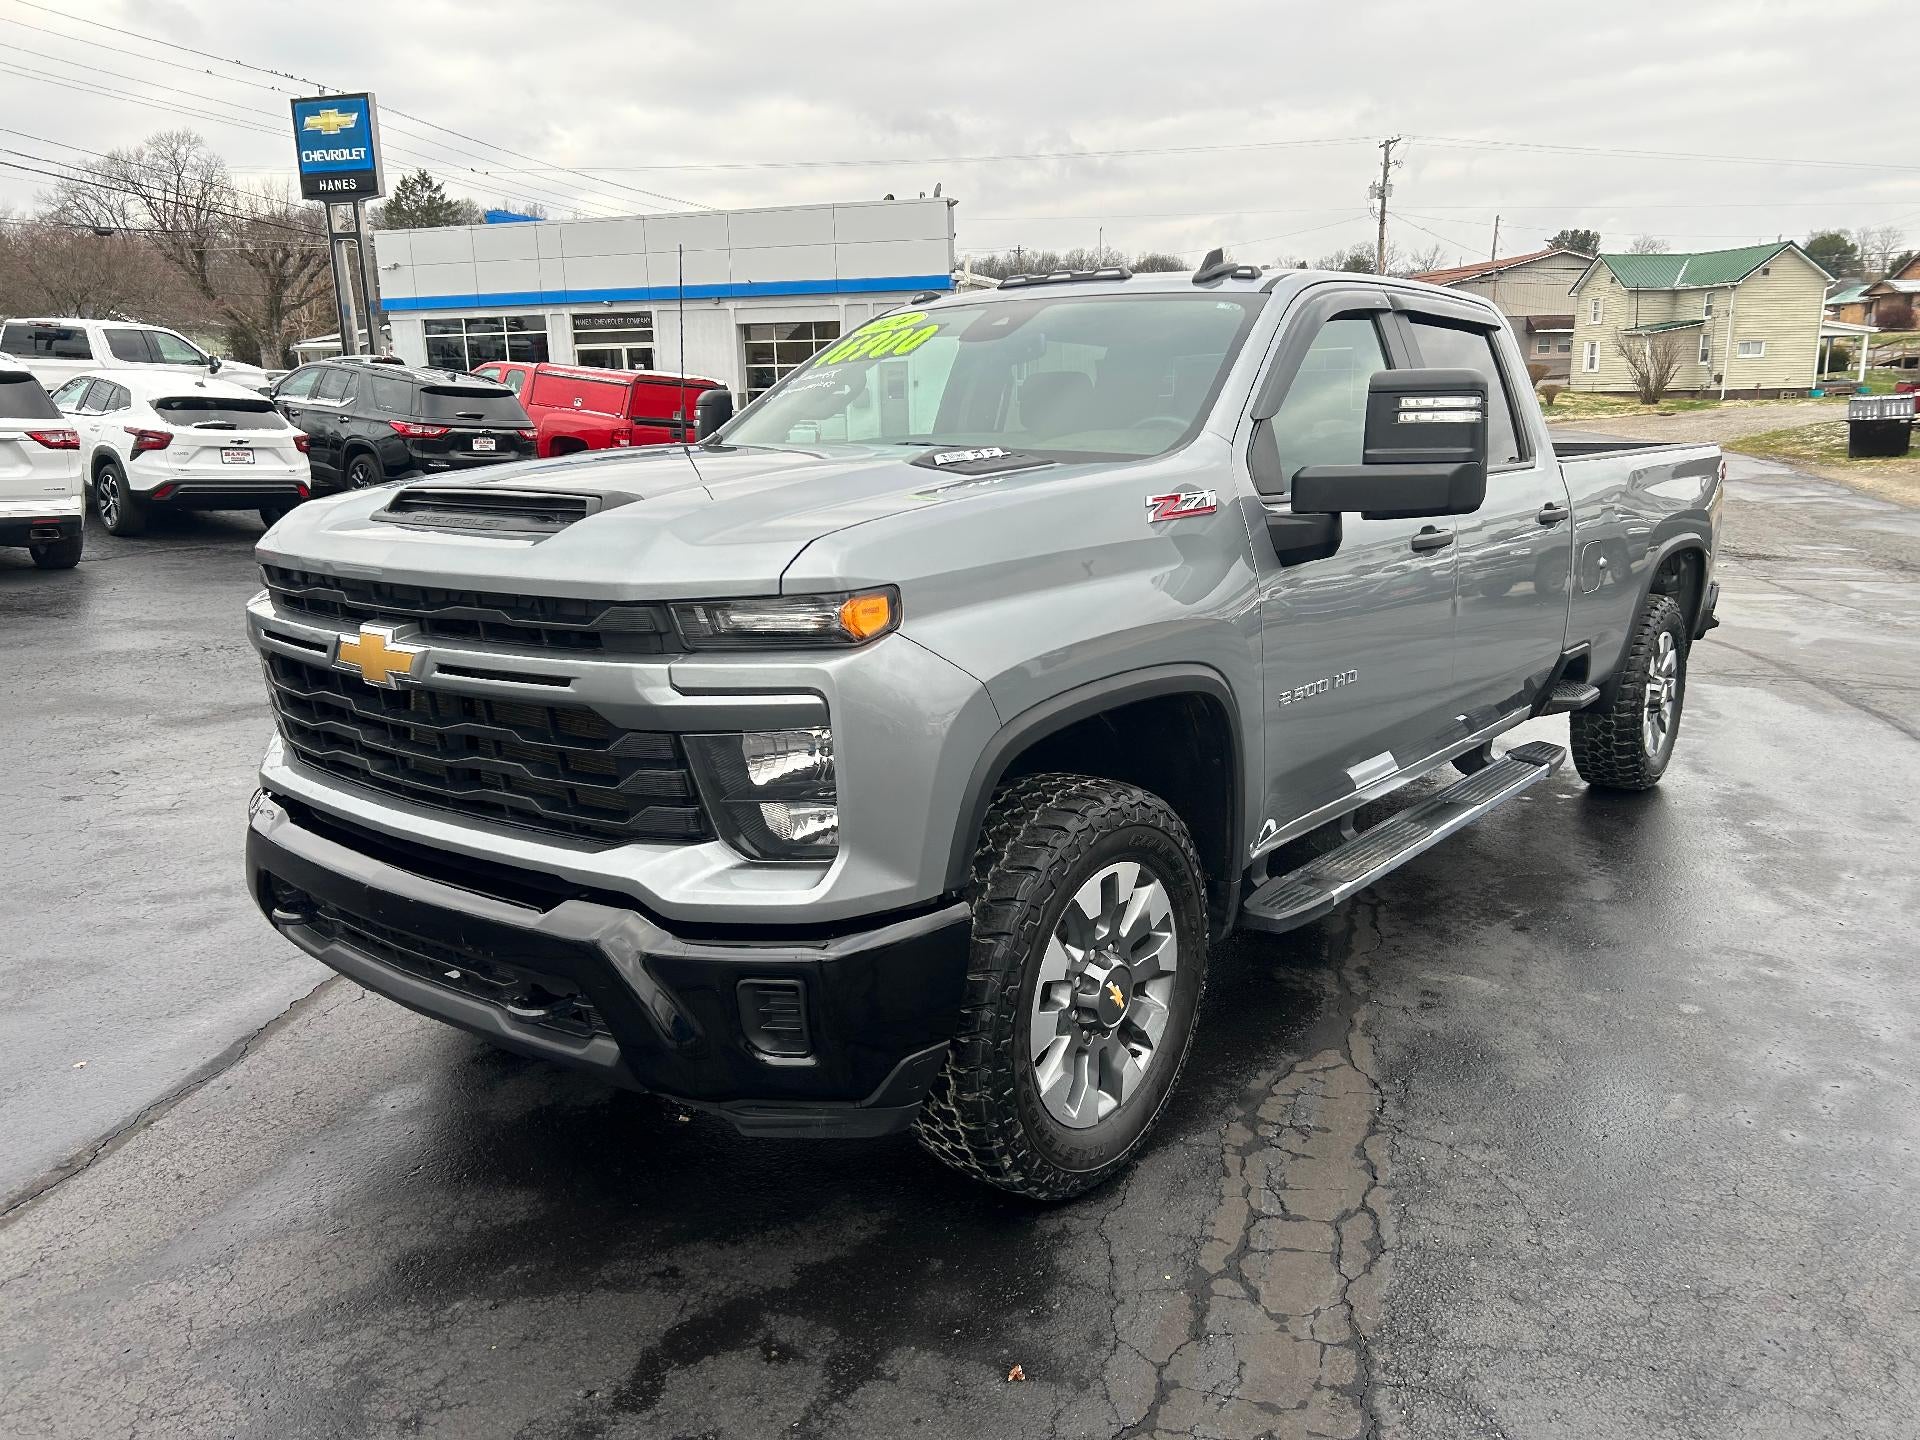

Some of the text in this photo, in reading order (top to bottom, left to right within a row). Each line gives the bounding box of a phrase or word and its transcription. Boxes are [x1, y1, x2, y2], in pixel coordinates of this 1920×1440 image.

[302, 147, 367, 163] CHEVROLET
[319, 178, 357, 191] HANES
[626, 316, 651, 325] COMPANY
[1144, 489, 1218, 523] Z71
[412, 515, 507, 528] CHEVROLET
[1278, 669, 1359, 706] 2500 HD
